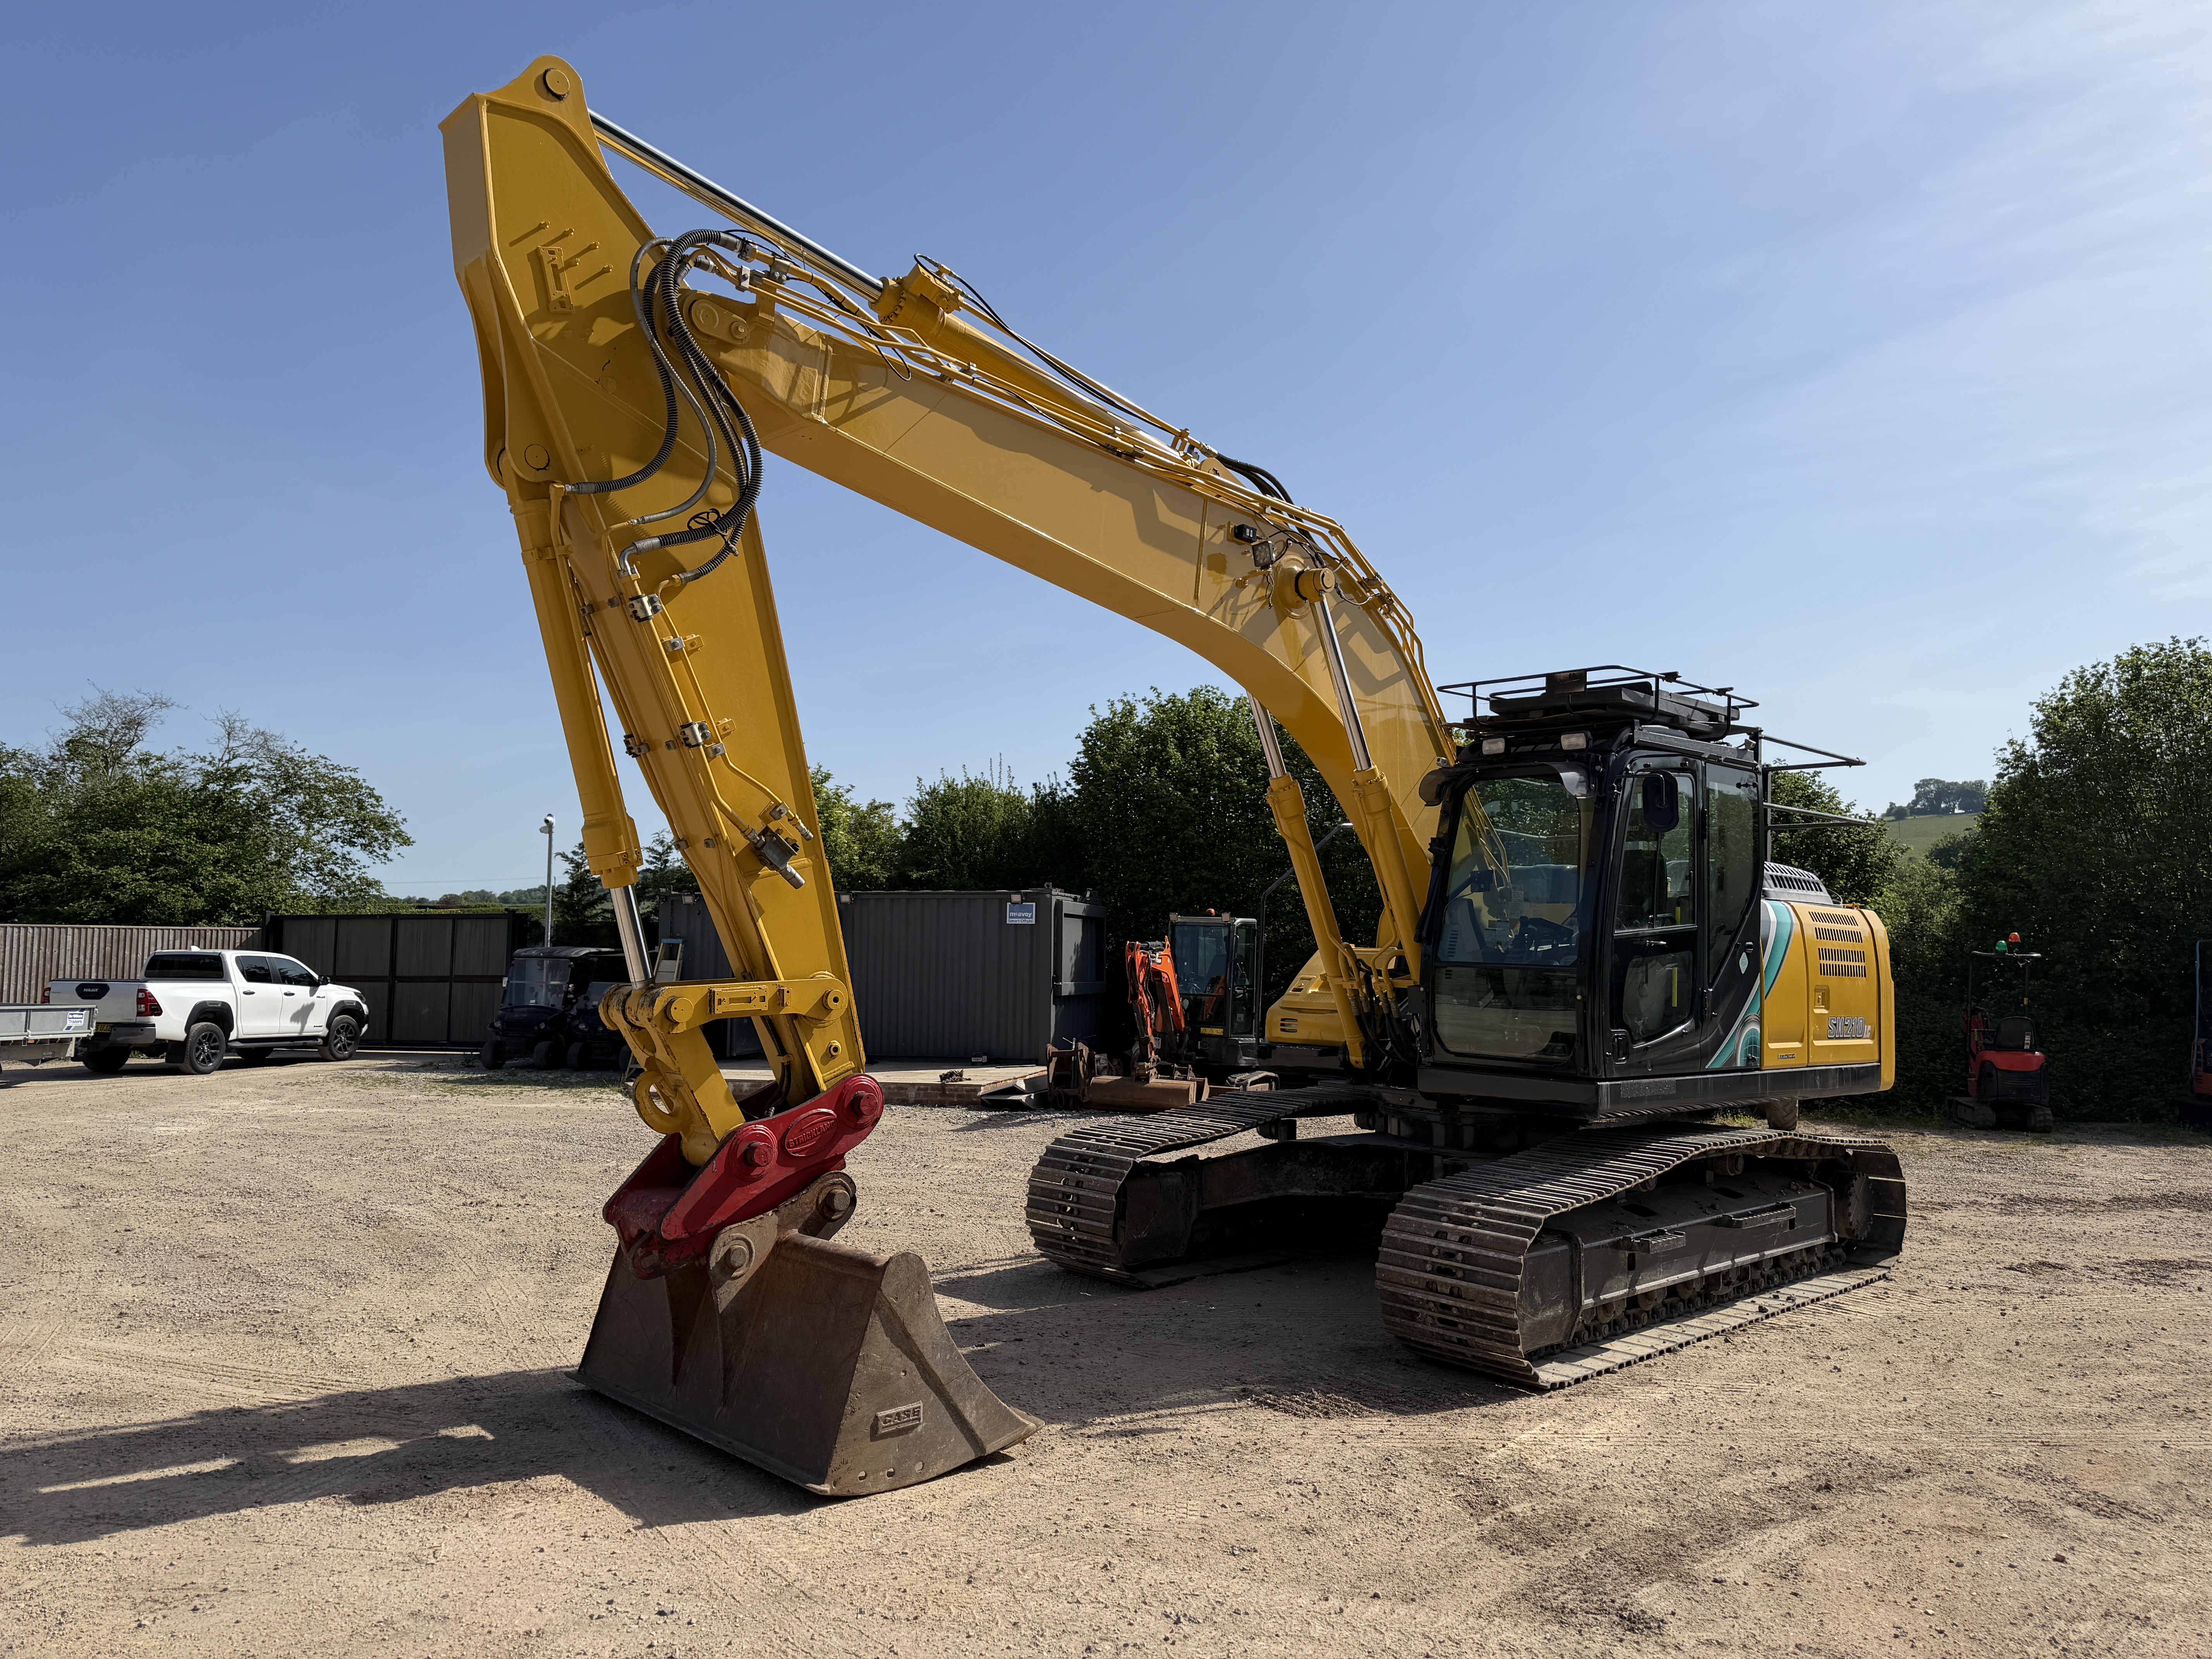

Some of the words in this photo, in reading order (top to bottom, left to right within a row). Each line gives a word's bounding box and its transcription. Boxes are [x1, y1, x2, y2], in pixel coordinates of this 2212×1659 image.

[1827, 1016, 1865, 1039] SK210
[1864, 1025, 1871, 1038] LC
[882, 1408, 921, 1426] CASE
